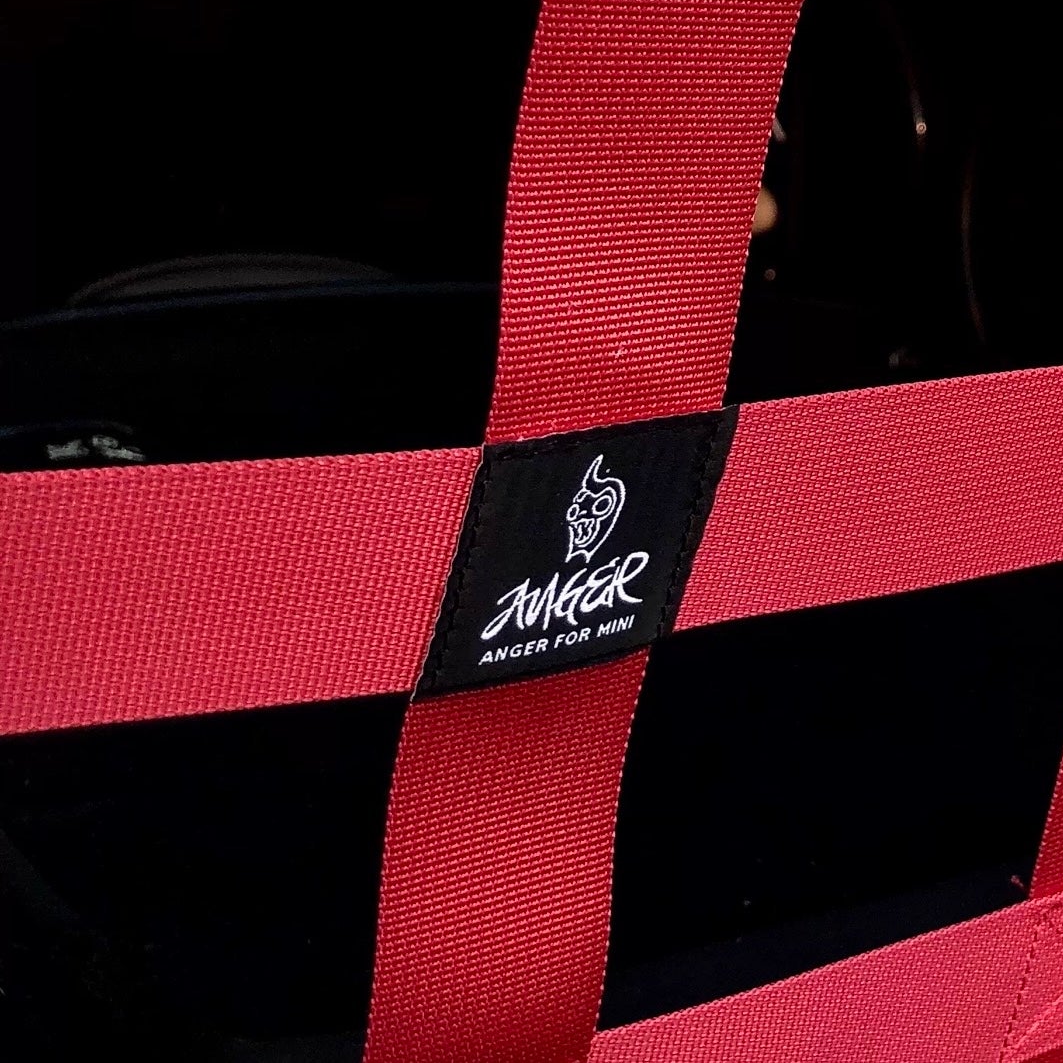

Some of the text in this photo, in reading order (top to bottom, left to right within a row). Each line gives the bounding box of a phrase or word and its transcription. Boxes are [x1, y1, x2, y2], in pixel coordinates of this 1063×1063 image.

[478, 614, 636, 665] ANGER FOR MINI
